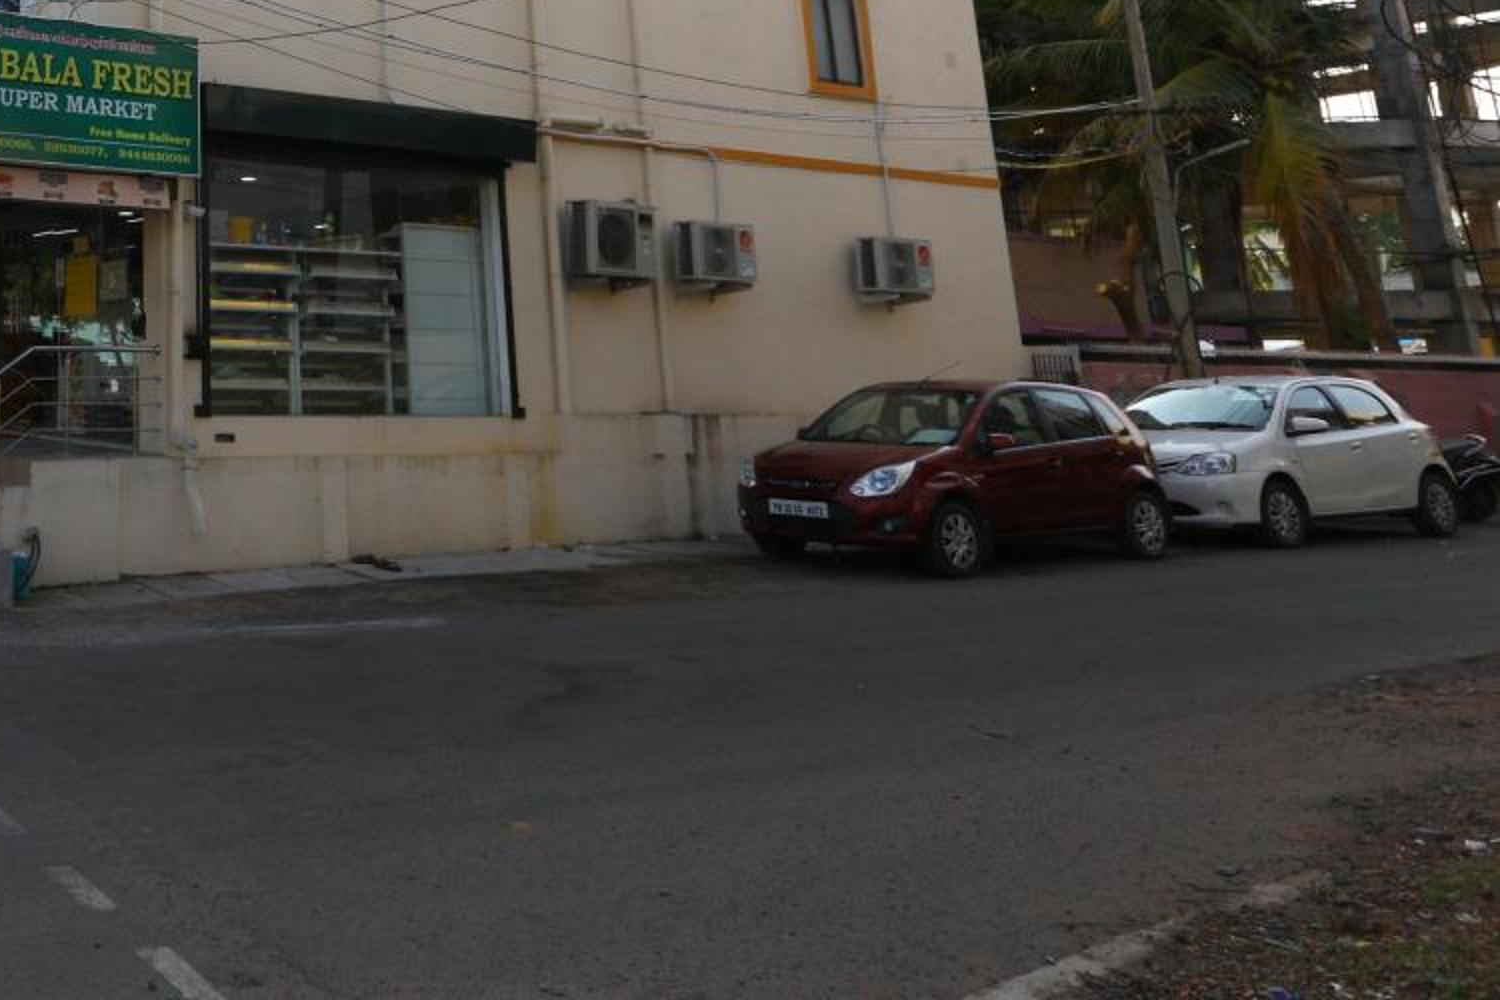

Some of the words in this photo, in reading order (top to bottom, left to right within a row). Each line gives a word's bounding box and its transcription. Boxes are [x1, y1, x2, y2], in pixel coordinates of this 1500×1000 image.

[92, 60, 193, 99] FRESH
[66, 94, 157, 121] MARKET
[89, 126, 113, 138] Free
